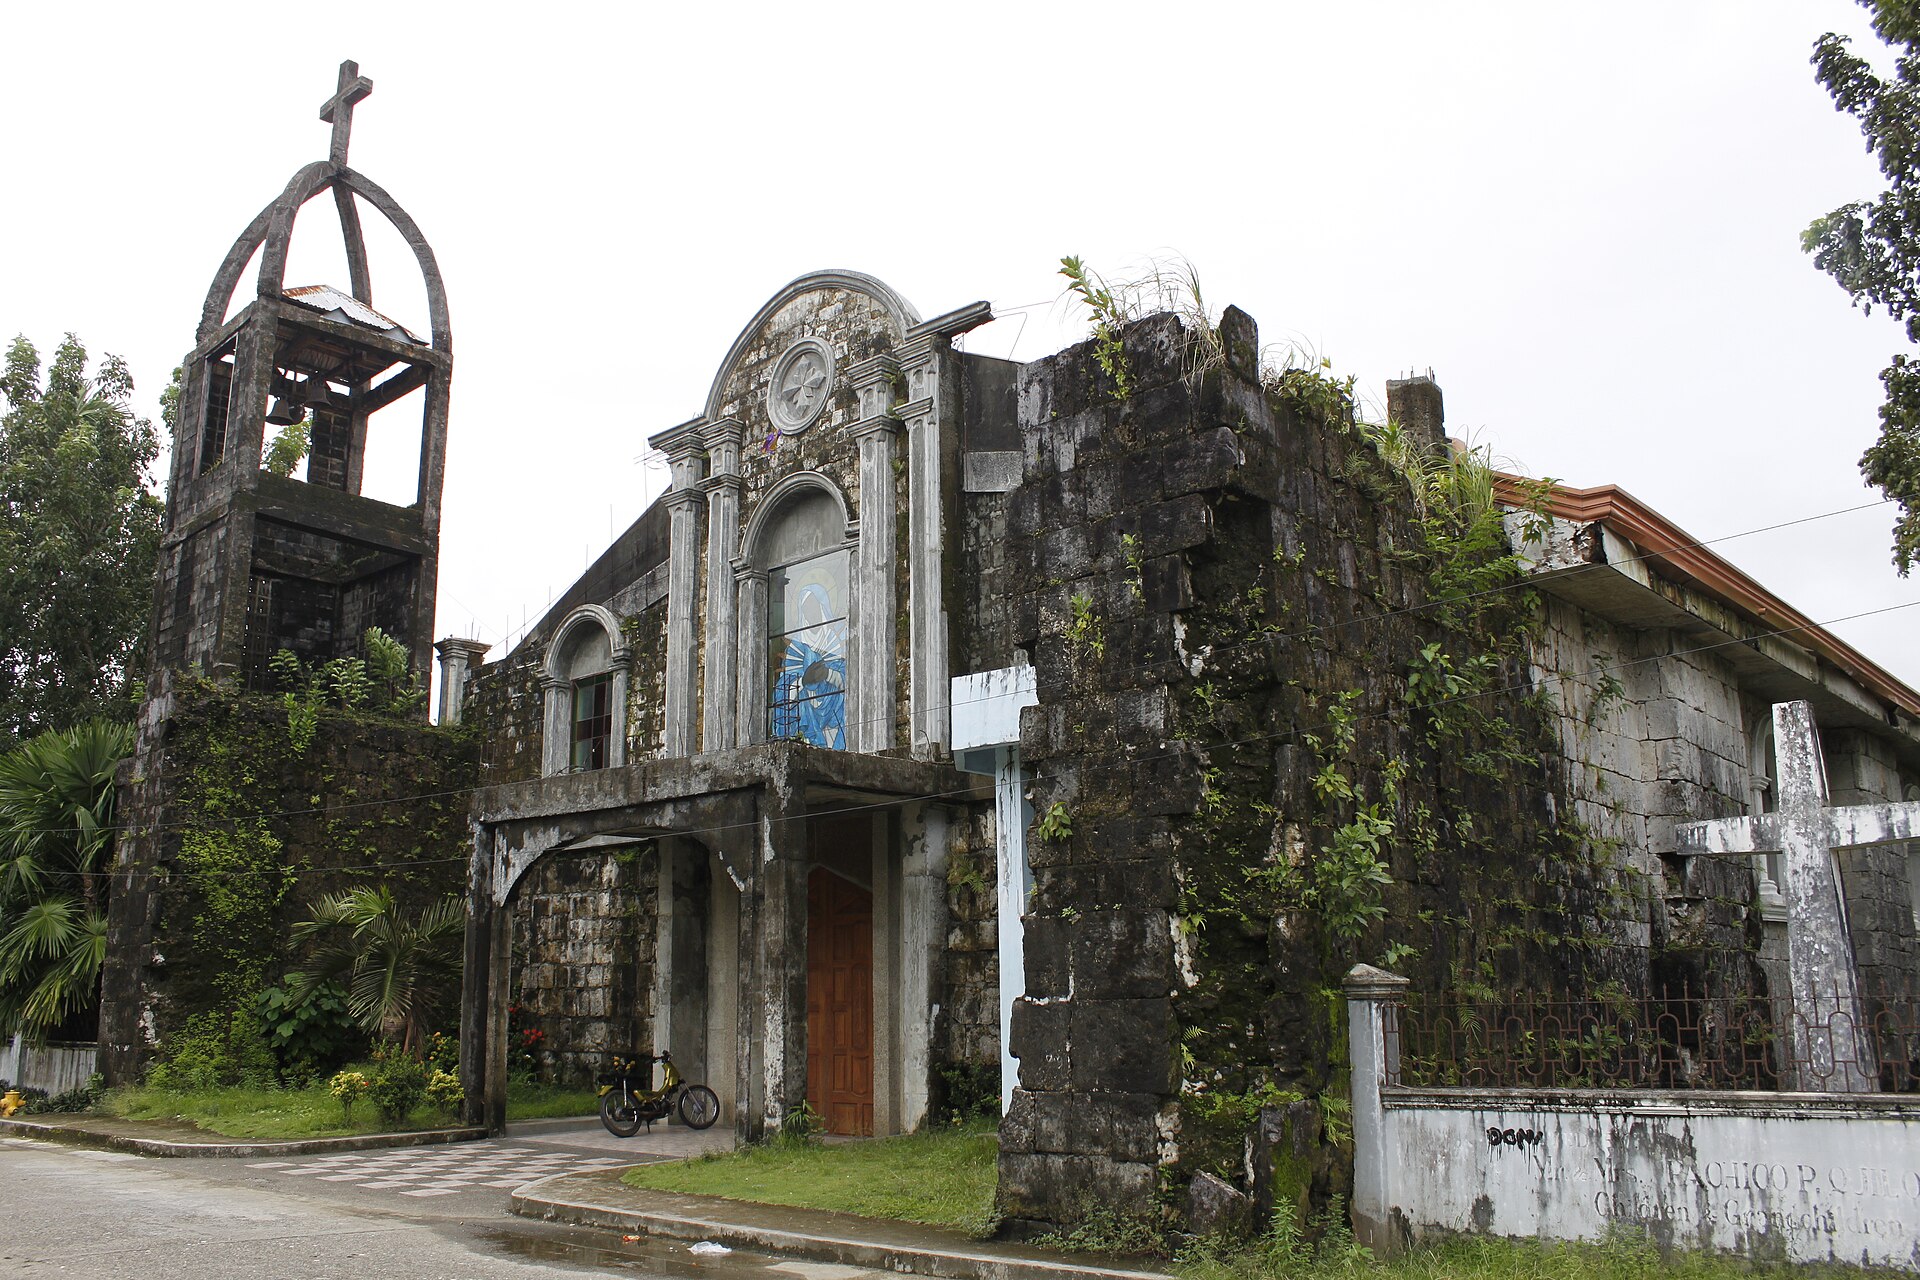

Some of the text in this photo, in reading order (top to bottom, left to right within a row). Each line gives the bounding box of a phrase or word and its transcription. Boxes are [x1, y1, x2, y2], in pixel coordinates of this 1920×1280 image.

[1797, 1164, 1821, 1194] P.
[1595, 1190, 1690, 1222] Children
[1724, 1199, 1905, 1237] Grandchildren
